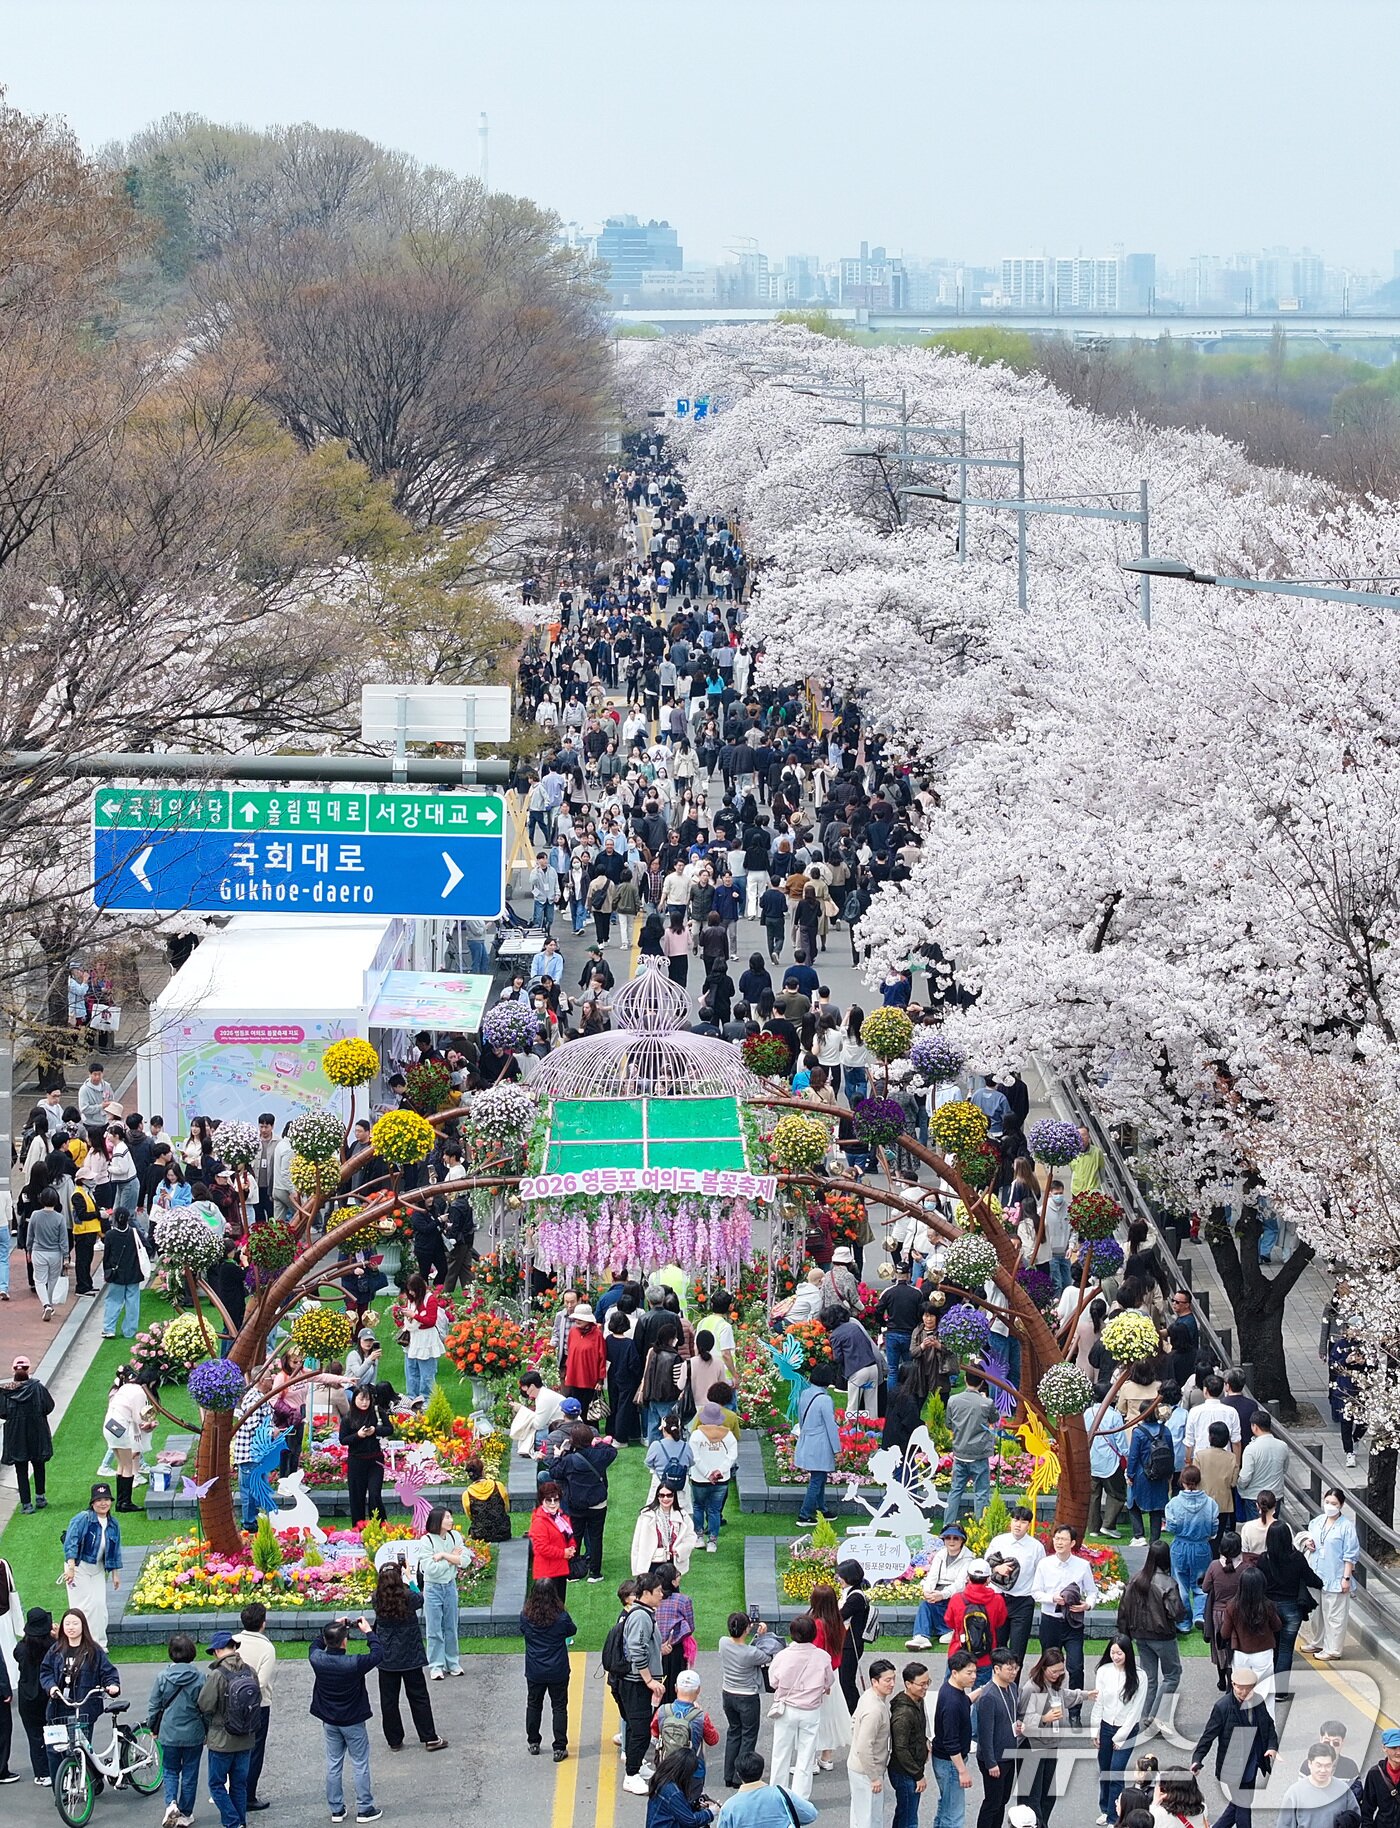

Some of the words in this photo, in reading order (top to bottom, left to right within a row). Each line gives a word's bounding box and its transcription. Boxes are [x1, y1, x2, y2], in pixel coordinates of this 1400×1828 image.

[128, 798, 223, 824] 국회의사당
[267, 799, 361, 826] 올림픽대로
[375, 802, 469, 829] 서강대교
[229, 841, 366, 876] 국회대로
[220, 878, 374, 903] Gukhoe-daero
[521, 1174, 577, 1198] 2026
[581, 1169, 638, 1193] 영등포
[642, 1169, 696, 1191] 여의도
[701, 1172, 775, 1200] 봄꽃축제
